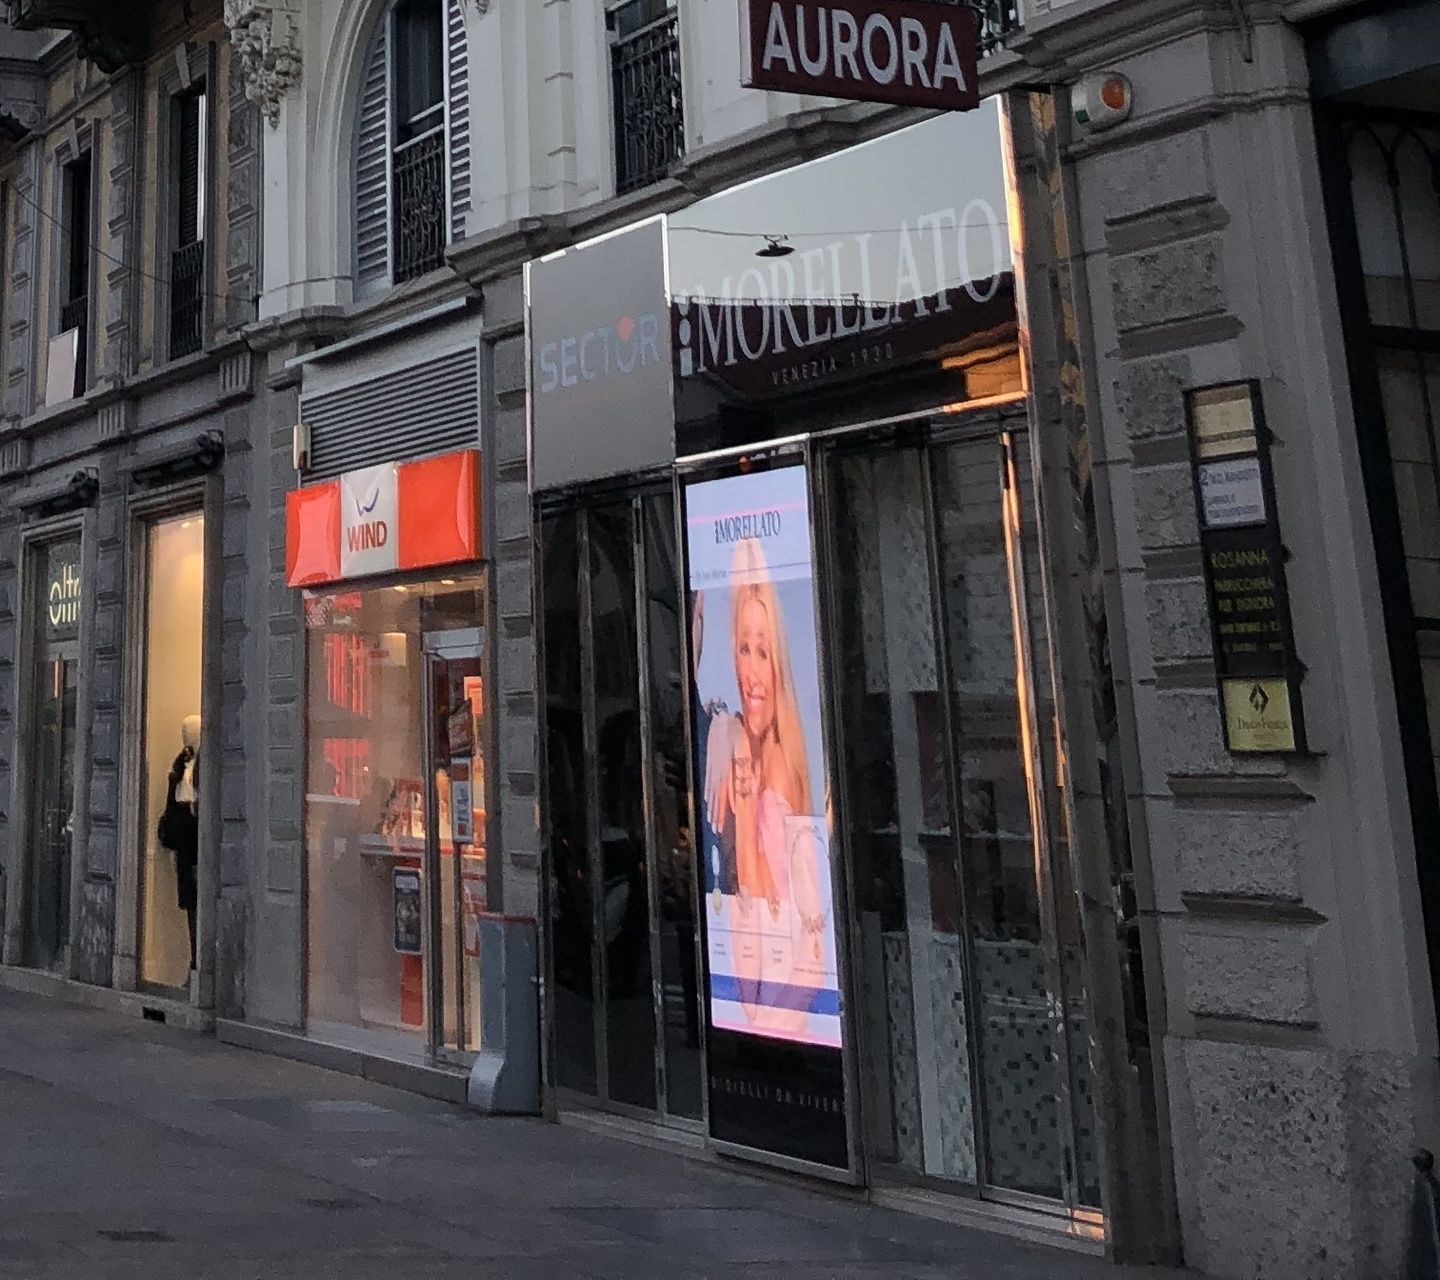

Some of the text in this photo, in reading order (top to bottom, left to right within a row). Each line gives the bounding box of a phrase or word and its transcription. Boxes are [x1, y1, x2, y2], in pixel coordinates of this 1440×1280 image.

[762, 1, 967, 94] AURORA
[692, 198, 1004, 373] MORELLATO
[540, 313, 661, 393] SECTOR
[771, 357, 838, 386] VENEZIA
[347, 520, 388, 552] WIND
[718, 510, 781, 543] MORELLATO
